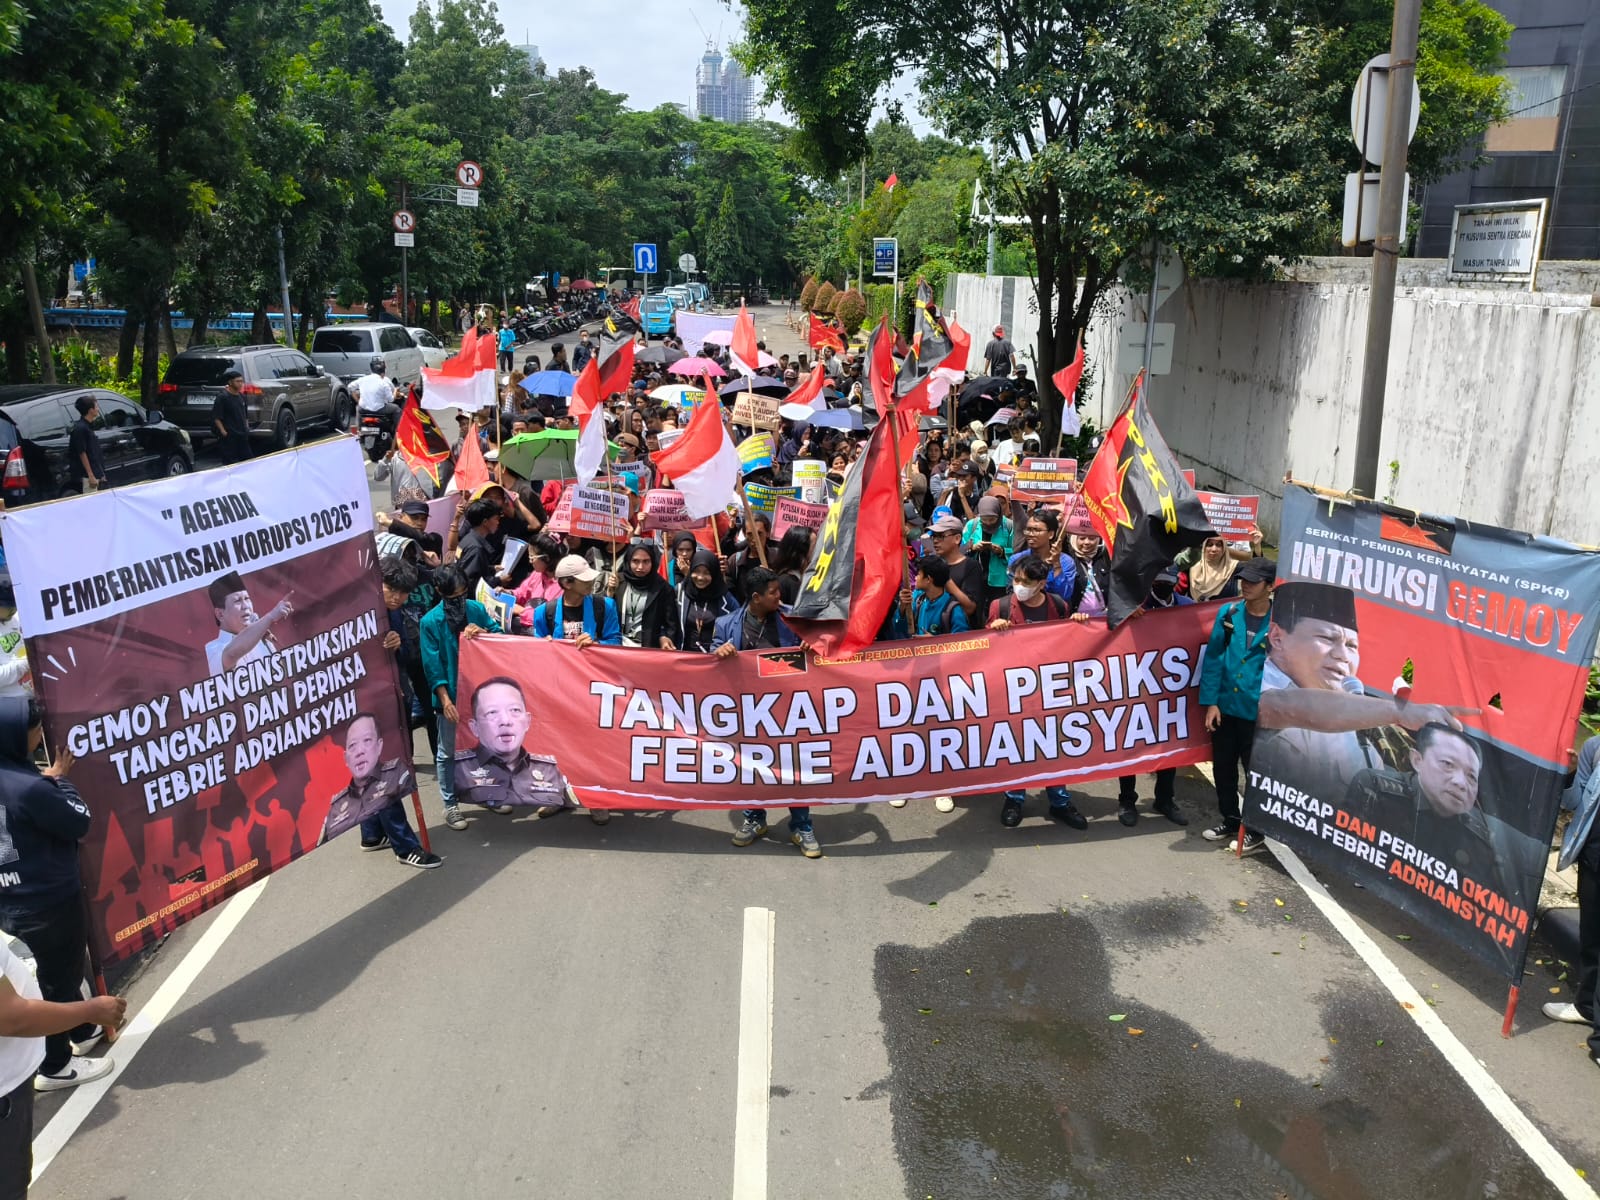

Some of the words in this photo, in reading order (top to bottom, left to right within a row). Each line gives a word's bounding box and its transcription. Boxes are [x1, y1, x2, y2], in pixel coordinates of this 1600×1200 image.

[1463, 259, 1485, 267] MASUK
[1486, 259, 1506, 267] TANPA
[1507, 259, 1521, 267] IJIN
[1466, 232, 1486, 241] KUSUMA
[1487, 231, 1506, 240] SENTRA
[1507, 230, 1531, 239] KENCANA
[1473, 218, 1493, 227] TANAH
[1494, 218, 1503, 226] INI
[1503, 217, 1520, 225] MILIK
[41, 546, 232, 621] PEMBERANTASAN
[234, 519, 312, 565] KORUPSI
[1291, 541, 1438, 612] INTRUKSI
[1446, 581, 1584, 655] GEMOY
[1304, 526, 1358, 545] SERIKAT
[1361, 540, 1413, 559] PEMUDA
[1416, 553, 1510, 585] KERAKYATAN
[1515, 577, 1570, 601] (SPKR)
[67, 695, 170, 759] GEMOY
[179, 608, 379, 720] MENGINSTRUKSIKAN
[864, 647, 913, 662] PEMUDA
[915, 638, 990, 657] KERAKYATAN
[109, 715, 238, 785] TANGKAP
[243, 687, 290, 733] DAN
[294, 651, 367, 707] PERIKSA
[589, 680, 858, 738] TANGKAP
[875, 671, 990, 730] DAN
[630, 735, 834, 785] FEBRIE
[850, 695, 1189, 782] ADRIANSYAH
[142, 751, 227, 815] FEBRIE
[233, 690, 358, 776] ADRIANSYAH
[1250, 770, 1334, 819] TANGKAP
[1336, 809, 1377, 843] DAN
[1378, 830, 1460, 890] PERIKSA
[1260, 798, 1319, 837] JAKSA
[1322, 823, 1388, 870] FEBRIE
[1388, 857, 1518, 949] ADRIANSYAH
[115, 911, 159, 943] SERIKAT
[159, 890, 200, 919] PEMUDA
[200, 857, 259, 895] KERAKYATAN
